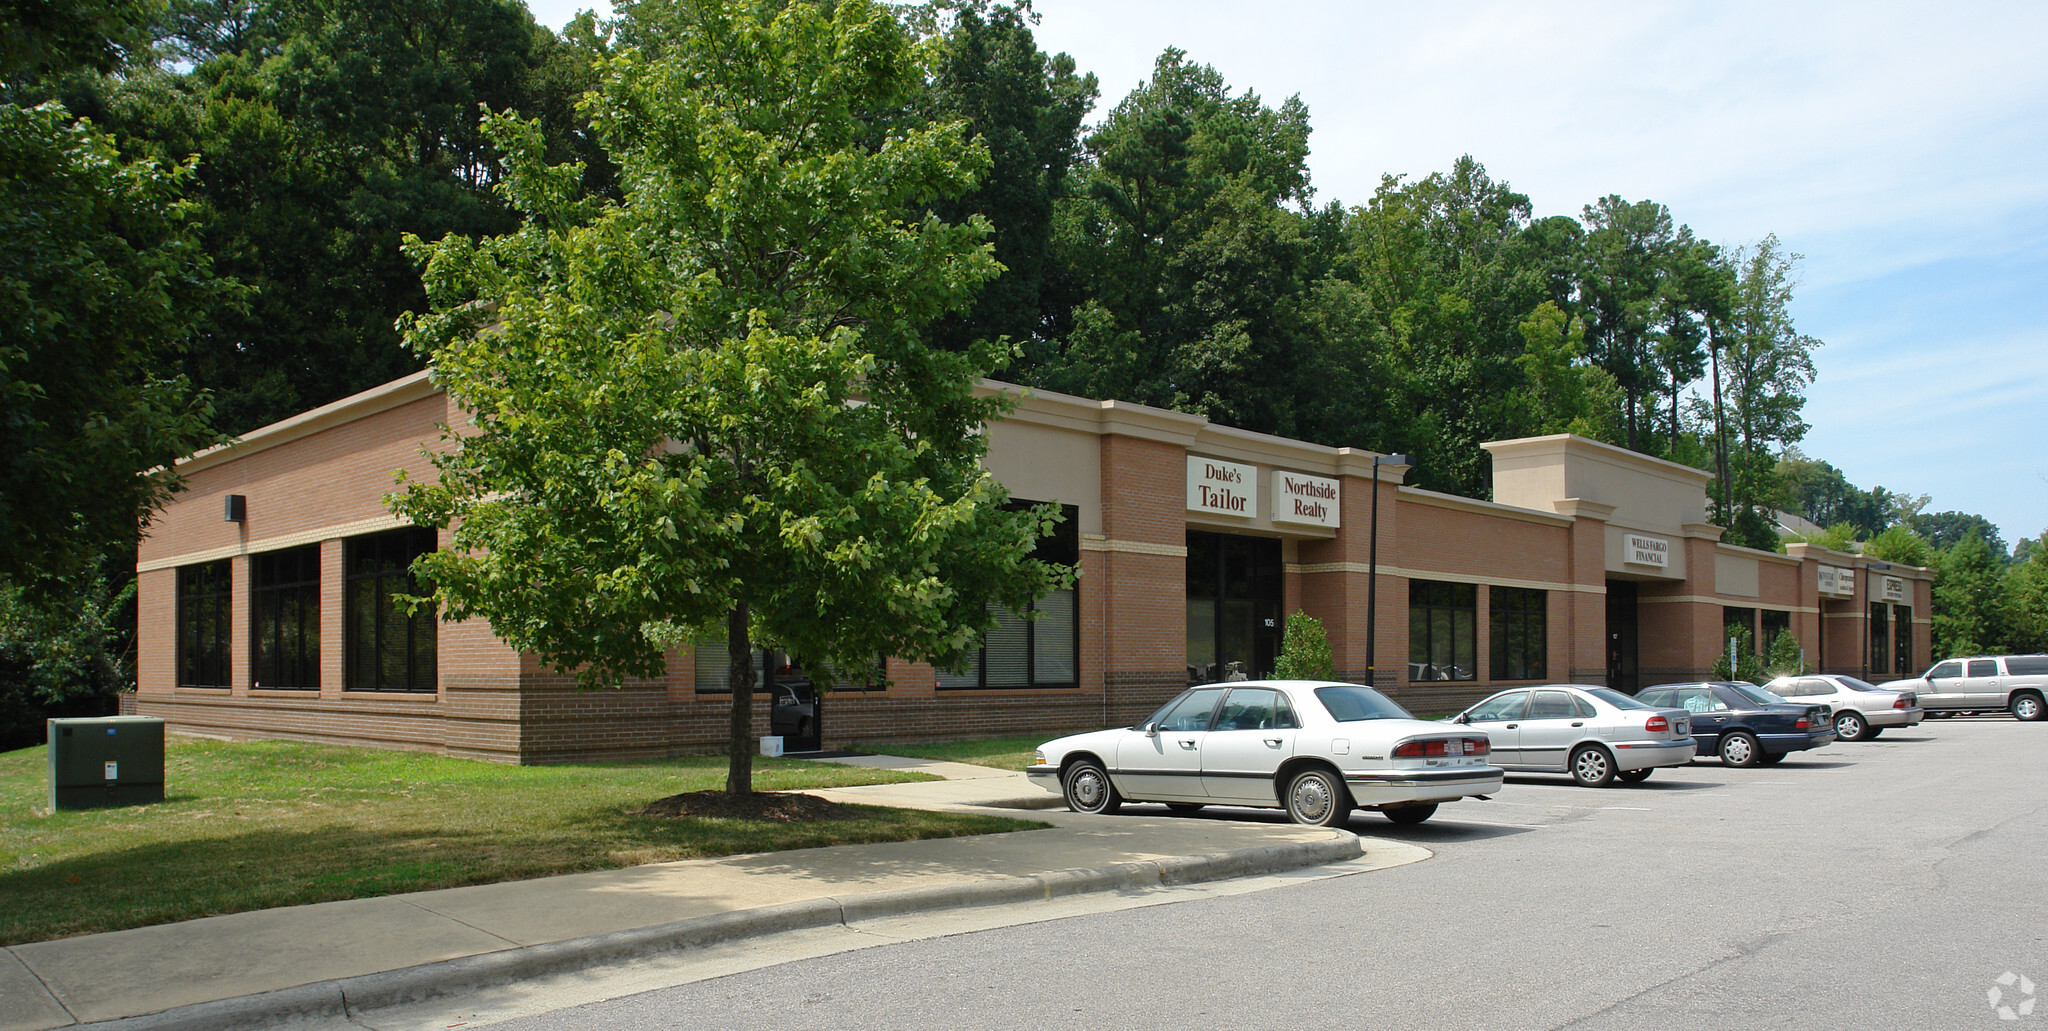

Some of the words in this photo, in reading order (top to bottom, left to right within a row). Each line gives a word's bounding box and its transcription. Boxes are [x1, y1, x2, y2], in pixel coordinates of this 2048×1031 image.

[1205, 463, 1242, 484] Duke's
[1198, 485, 1247, 512] Tailor
[1284, 477, 1336, 500] Northside
[1294, 498, 1328, 523] Realty
[1632, 538, 1649, 549] WELLS
[1650, 541, 1666, 552] FARGO
[1636, 551, 1663, 563] FINANCIAL
[1264, 618, 1275, 627] 105
